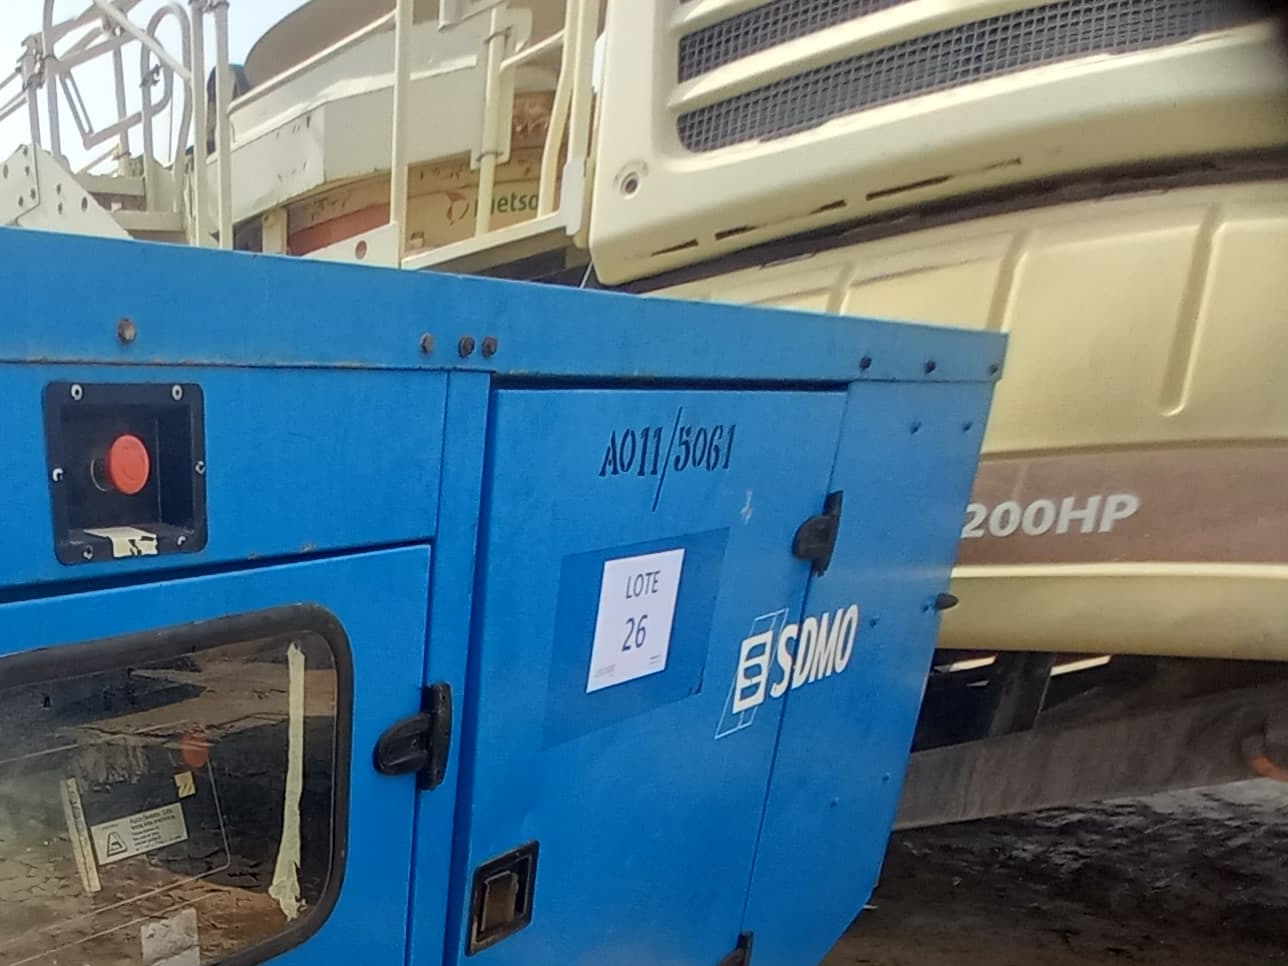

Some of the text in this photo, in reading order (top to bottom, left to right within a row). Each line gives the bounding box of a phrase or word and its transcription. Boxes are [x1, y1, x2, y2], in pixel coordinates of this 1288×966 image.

[960, 493, 1139, 538] 200HP
[626, 570, 661, 599] LOTE
[622, 614, 648, 652] 26
[770, 603, 859, 698] SDMO
